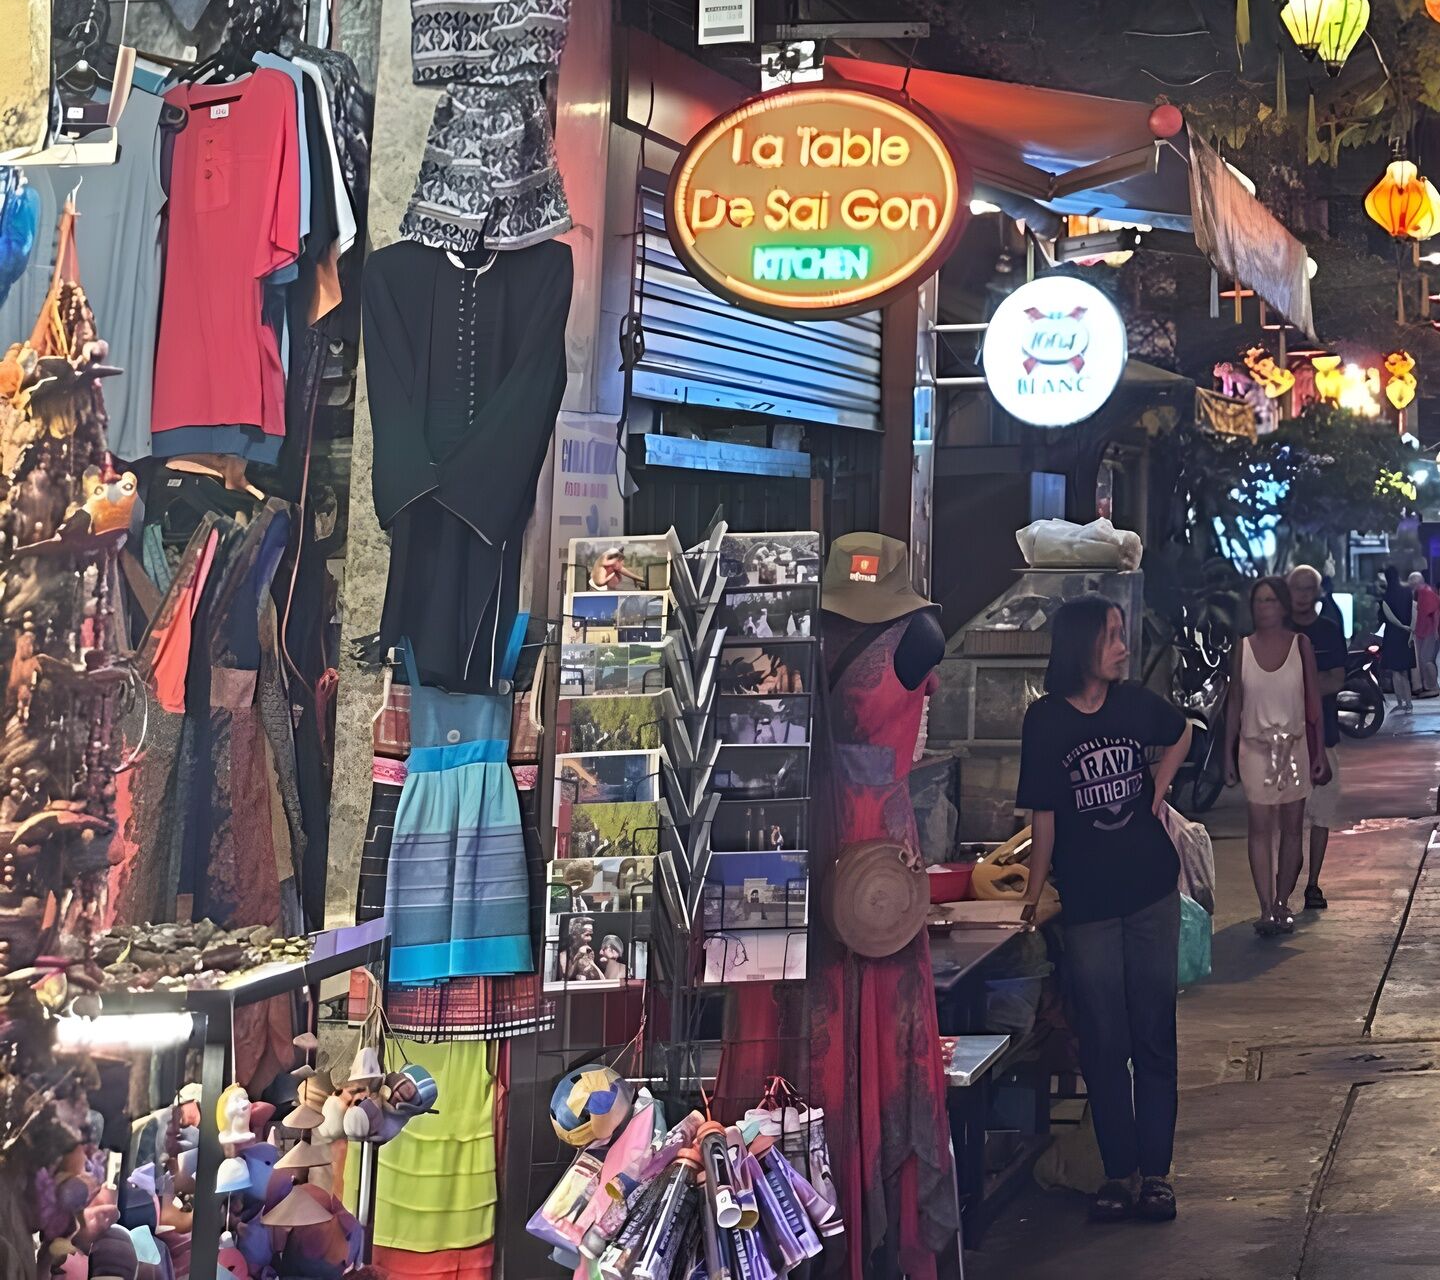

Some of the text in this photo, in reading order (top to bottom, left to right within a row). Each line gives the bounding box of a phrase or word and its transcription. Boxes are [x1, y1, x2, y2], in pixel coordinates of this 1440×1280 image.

[796, 125, 911, 169] Table
[691, 188, 938, 232] De Sai Gon
[753, 245, 870, 281] KITCHEN
[1083, 748, 1131, 779] RAW
